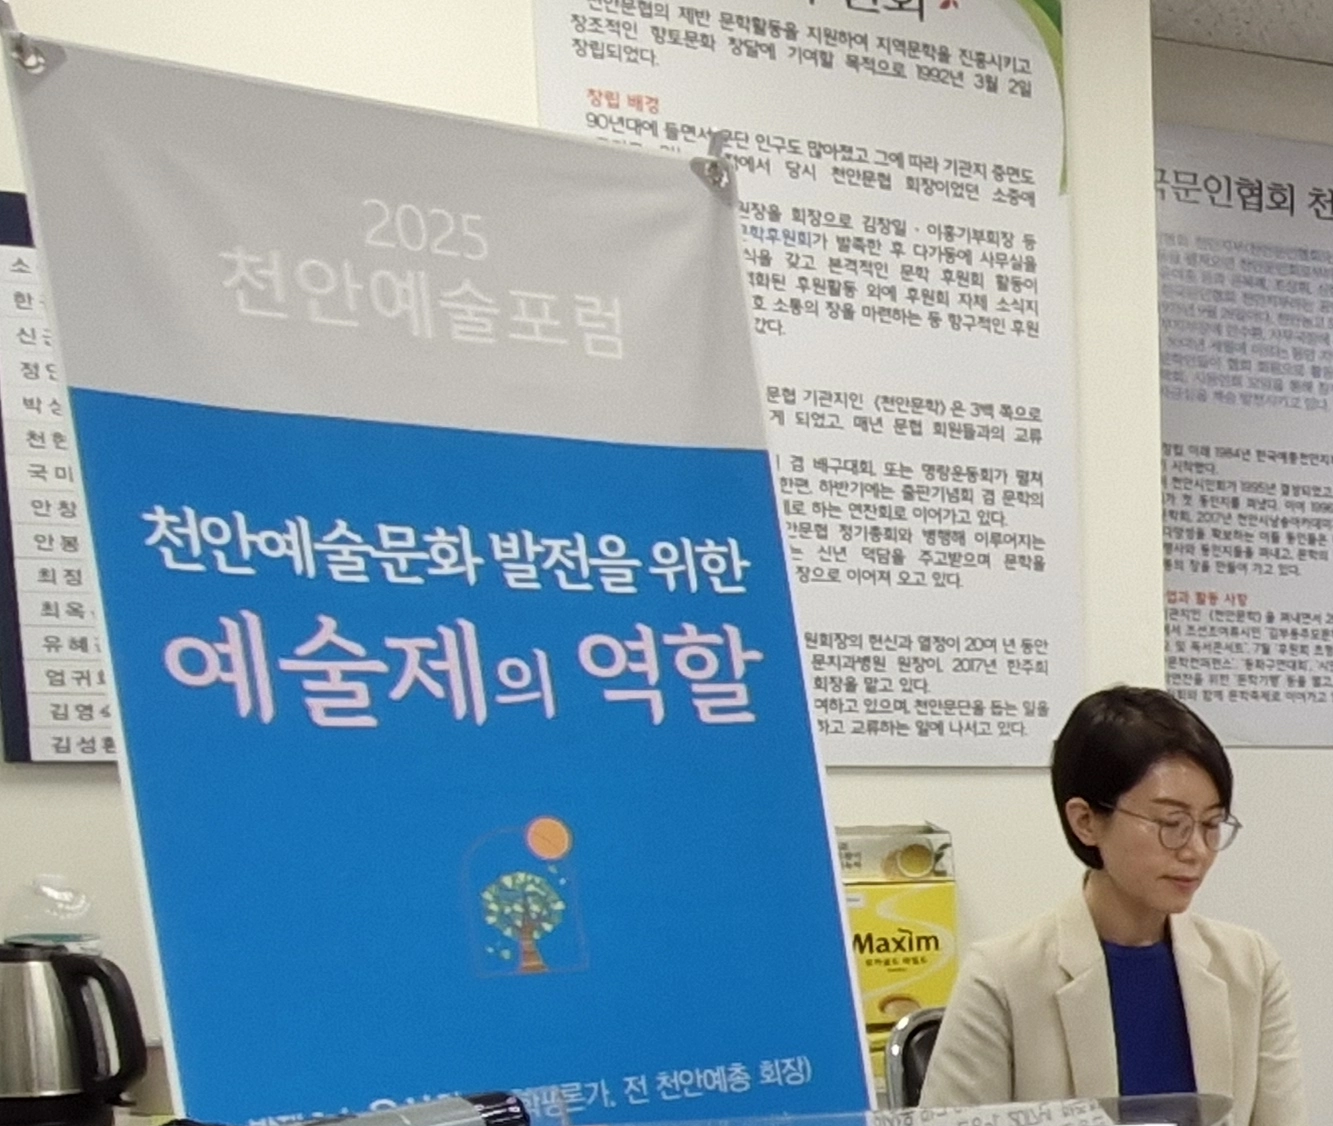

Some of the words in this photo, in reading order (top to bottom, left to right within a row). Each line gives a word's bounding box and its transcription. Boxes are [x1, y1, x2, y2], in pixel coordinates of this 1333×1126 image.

[627, 94, 660, 114] 배경
[362, 199, 489, 262] 2025
[219, 243, 625, 361] 천안예술포럼
[141, 505, 484, 588] 천안예술문화
[490, 529, 642, 595] 발전을
[648, 538, 751, 597] 위한
[163, 610, 556, 729] 예술제의
[578, 622, 764, 725] 역할
[853, 928, 939, 955] Maxim
[622, 1074, 649, 1104] 전
[656, 1061, 750, 1094] 천안예총
[759, 1056, 813, 1086] 회장)
